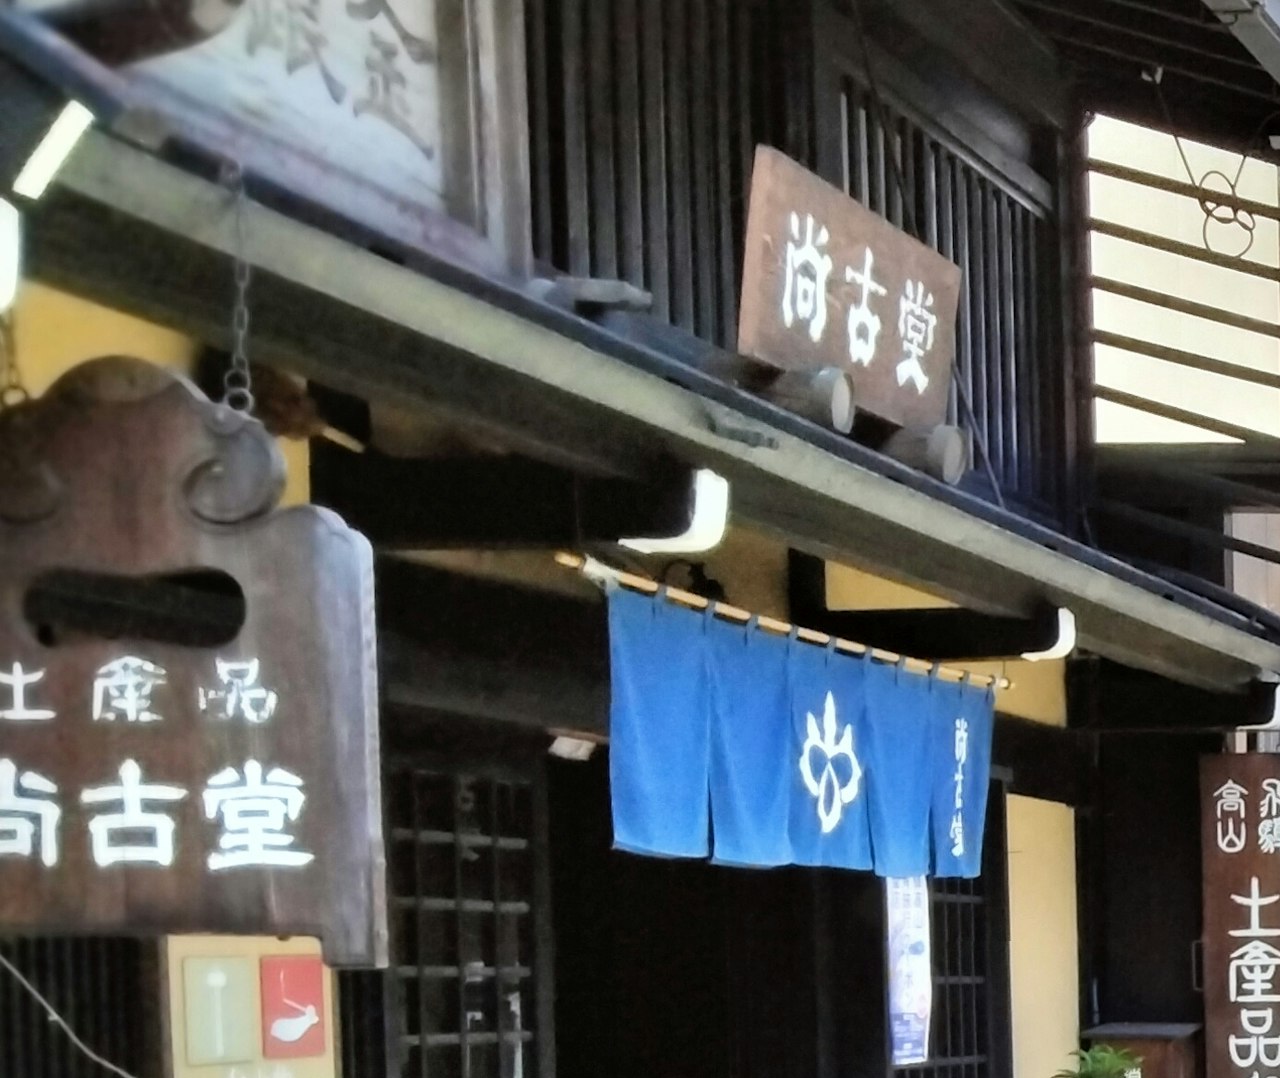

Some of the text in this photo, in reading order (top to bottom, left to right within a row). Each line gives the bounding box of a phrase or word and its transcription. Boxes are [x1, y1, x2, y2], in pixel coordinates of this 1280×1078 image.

[782, 210, 937, 395] 尚古堂
[1213, 778, 1249, 854] 高山
